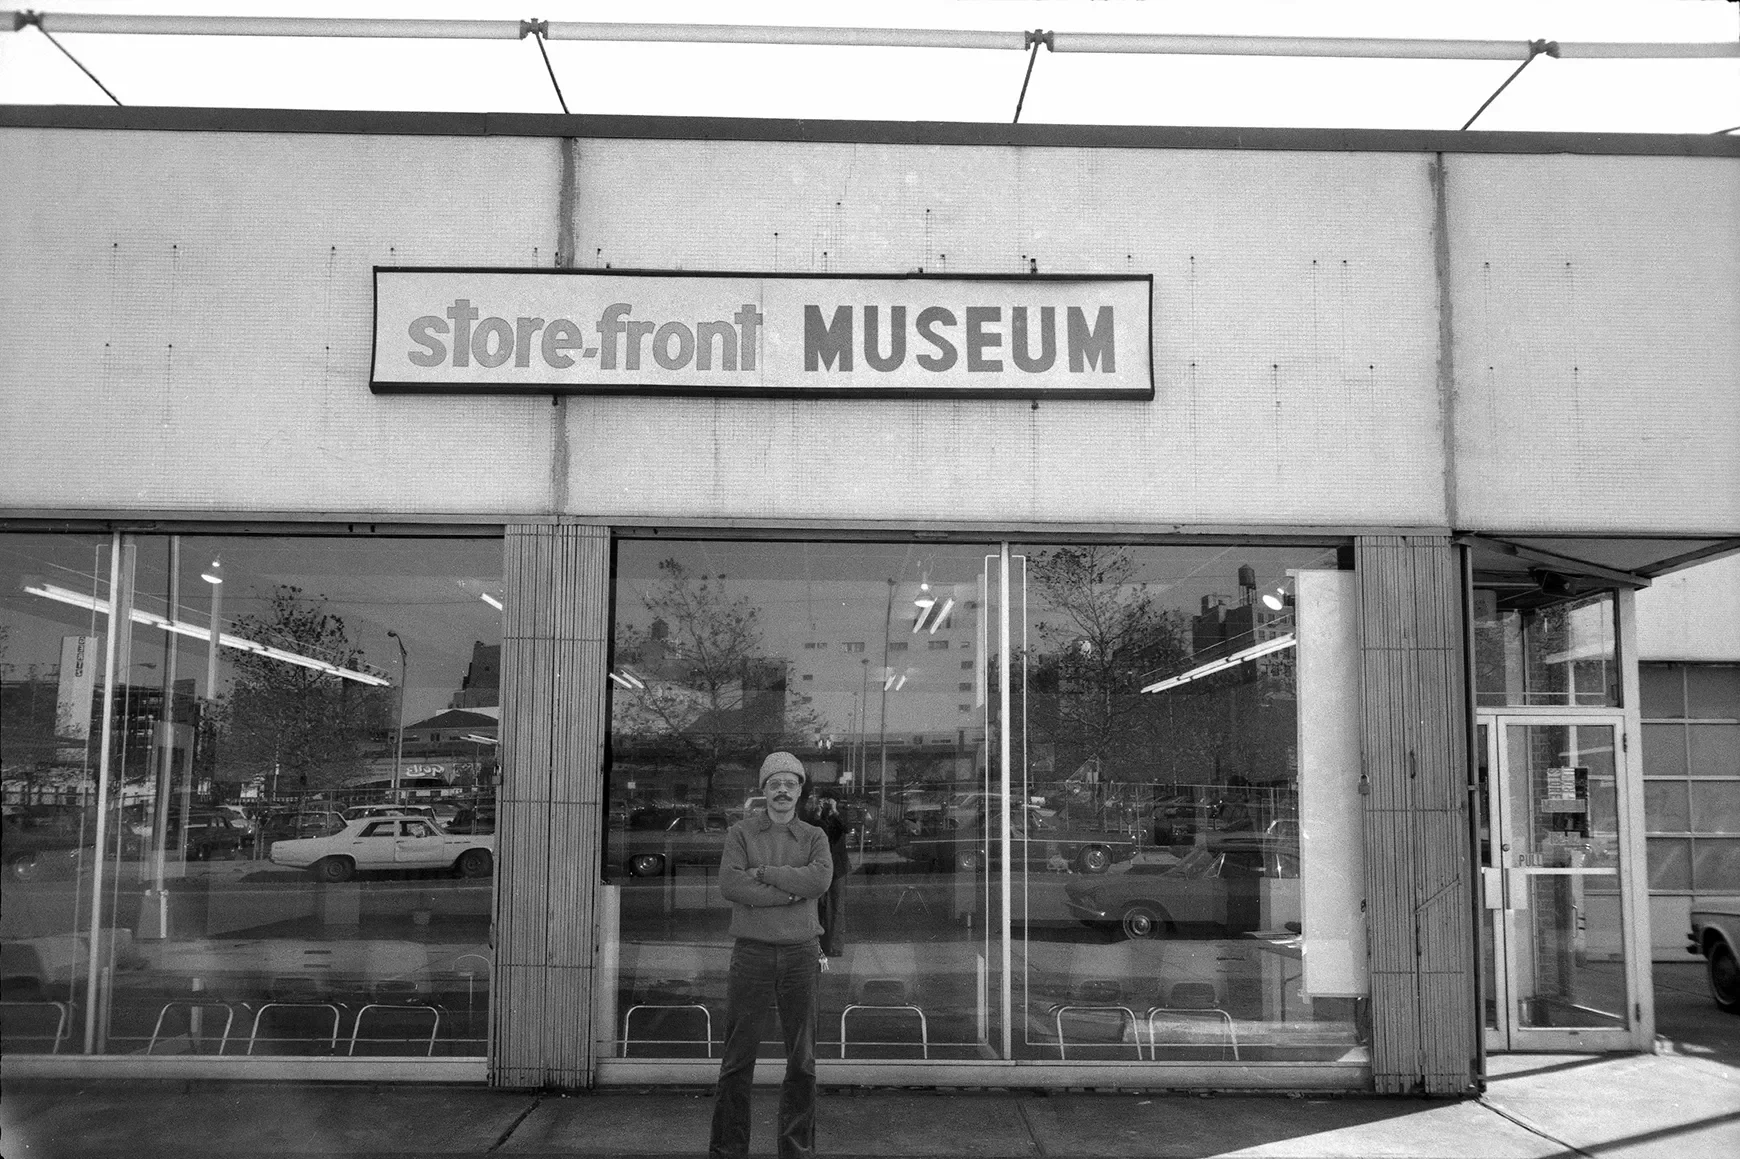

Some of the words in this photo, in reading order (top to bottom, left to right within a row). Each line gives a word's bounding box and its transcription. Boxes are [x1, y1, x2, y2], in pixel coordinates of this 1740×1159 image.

[408, 299, 763, 372] store-front
[803, 304, 1116, 374] MUSEUM
[1519, 854, 1543, 867] PULL
